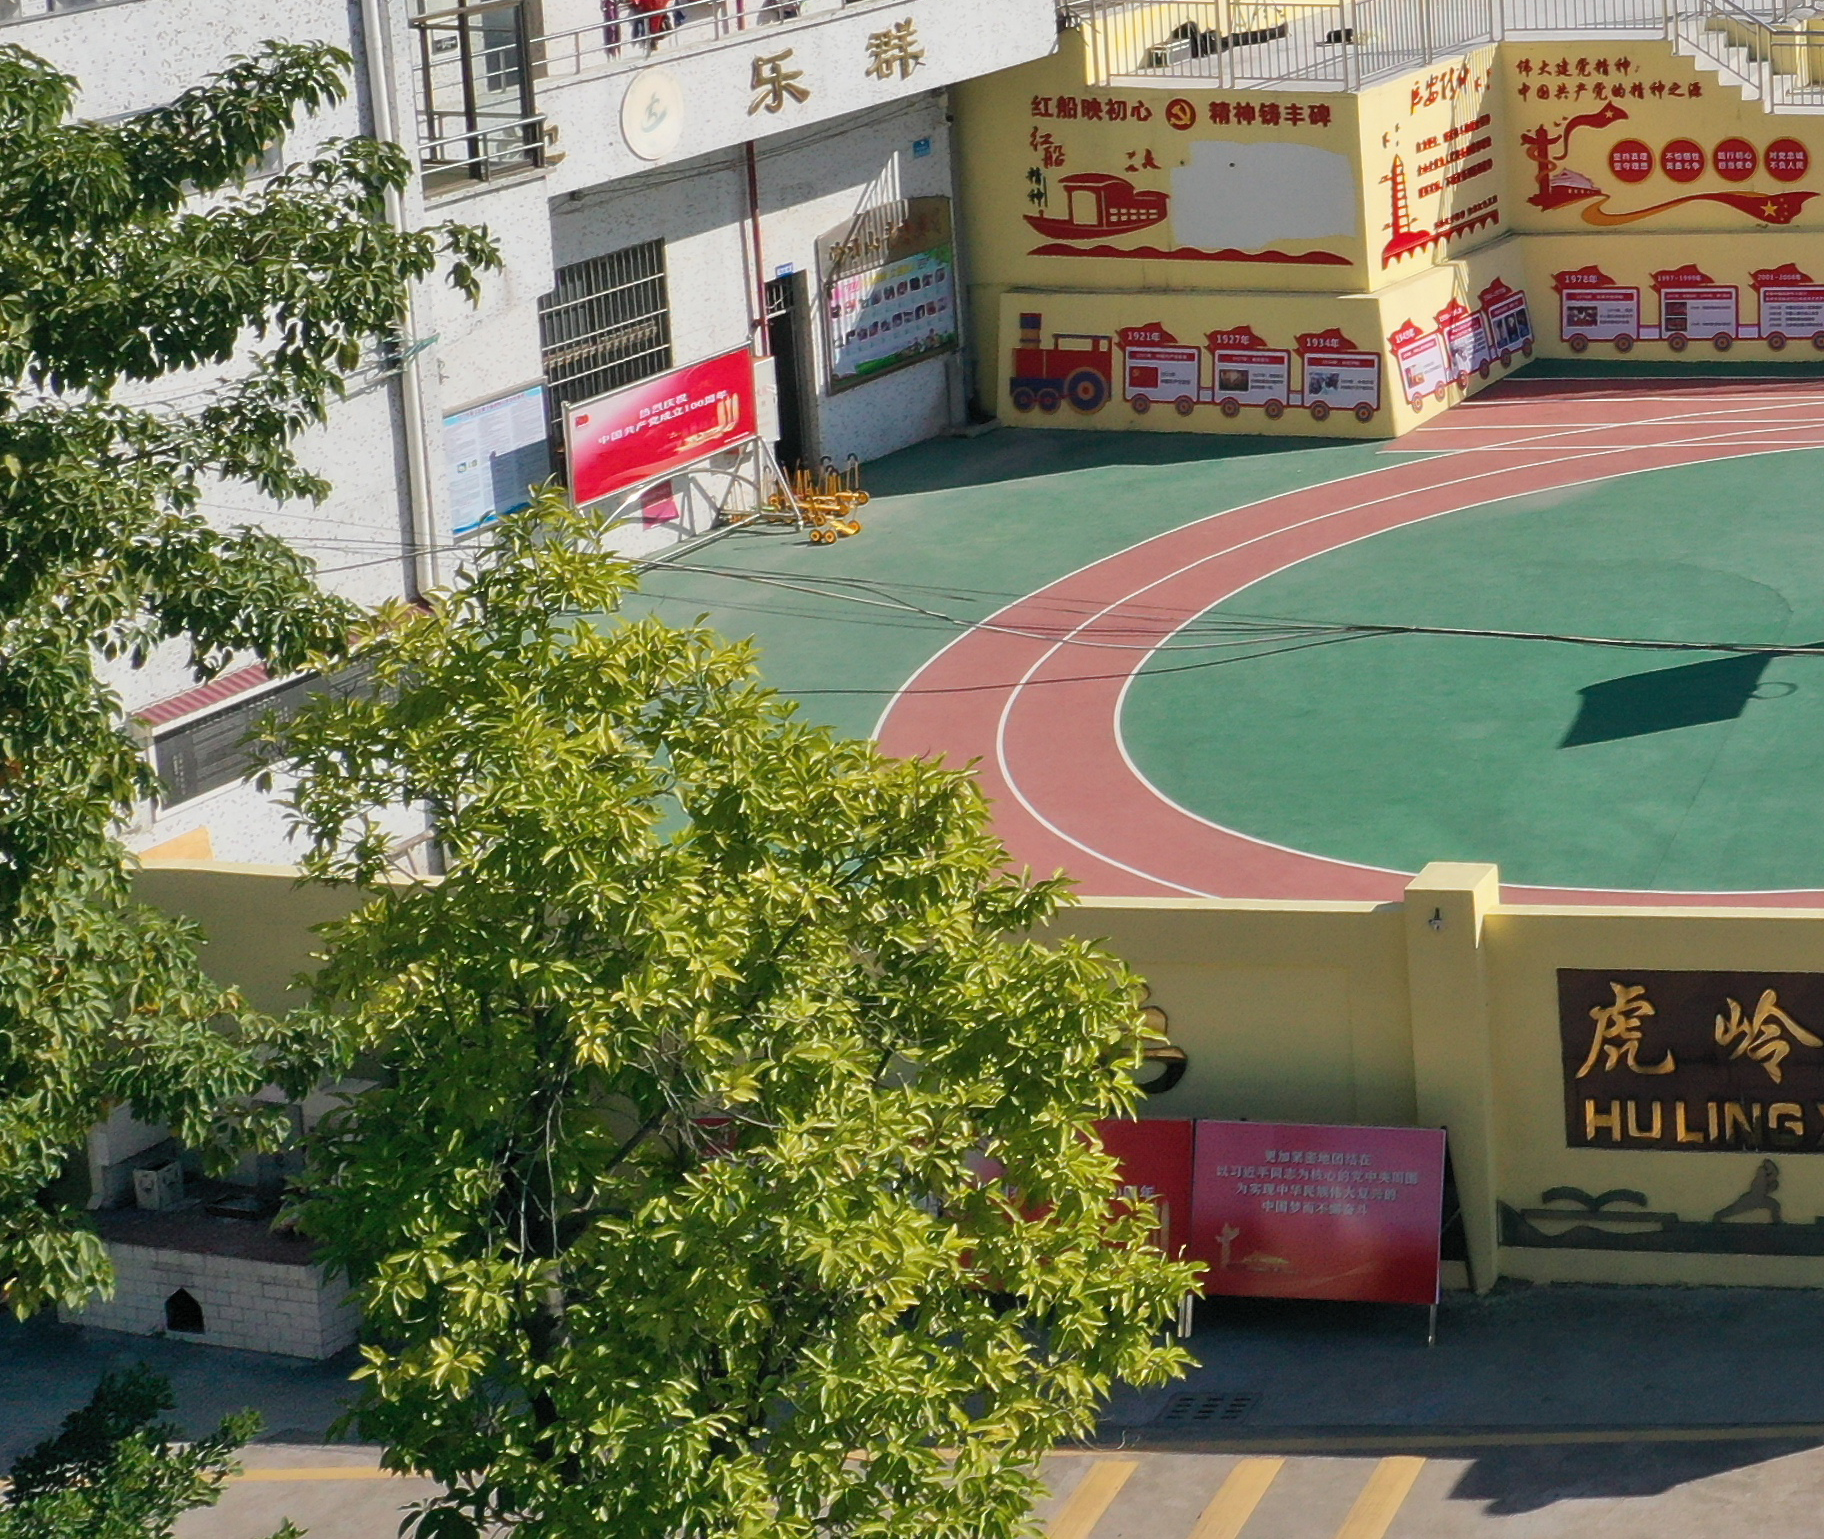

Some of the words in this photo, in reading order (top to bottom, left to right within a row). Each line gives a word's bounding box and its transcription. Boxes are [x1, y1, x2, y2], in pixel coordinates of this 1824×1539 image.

[747, 16, 927, 117] 乐群
[1517, 80, 1703, 102] 中国共产党的精神之源
[1031, 95, 1153, 122] 红船映初心
[1209, 101, 1331, 128] 精神铸丰碑
[1030, 126, 1066, 169] 红船
[1127, 332, 1162, 342] 1921年
[1216, 334, 1250, 345] 1927年
[1306, 338, 1340, 348] 1934年
[1586, 1098, 1662, 1142] HU
[1676, 1100, 1804, 1145] LING
